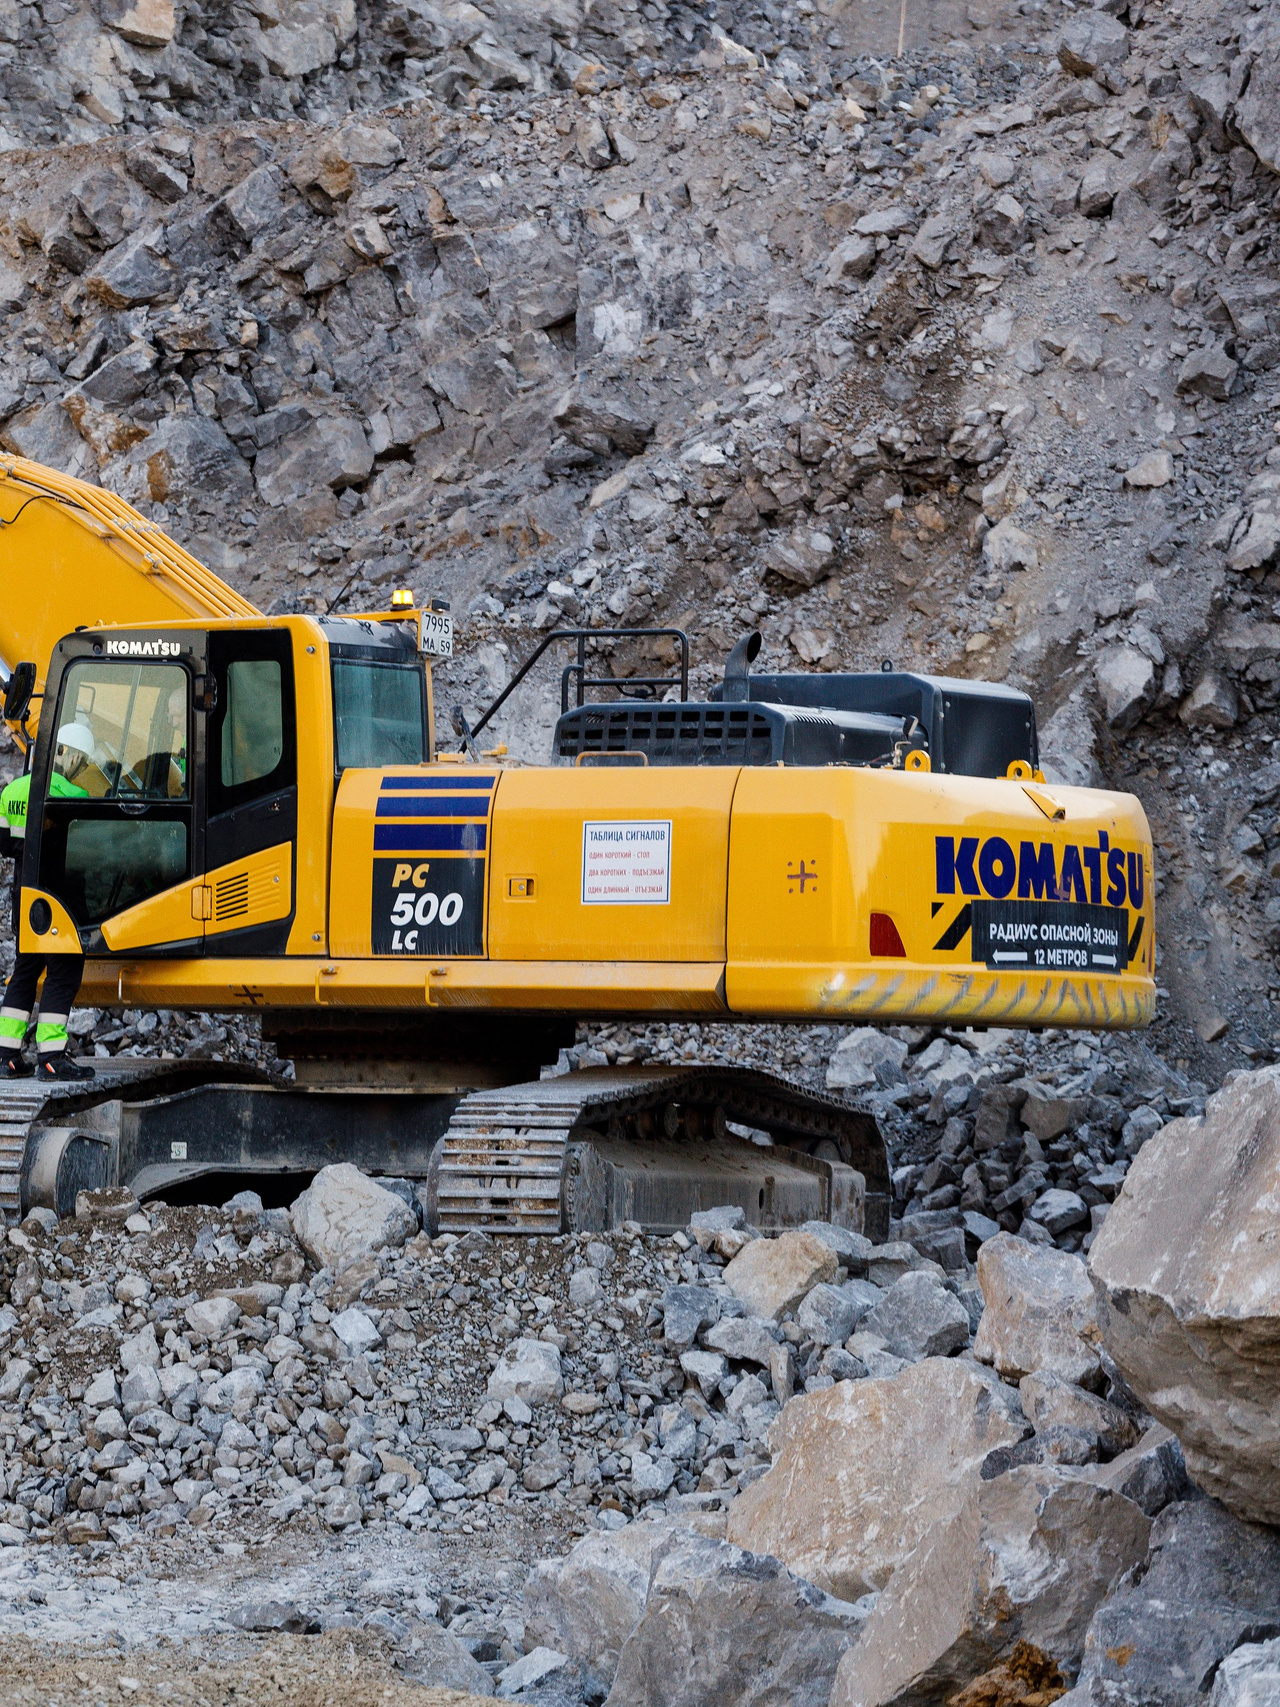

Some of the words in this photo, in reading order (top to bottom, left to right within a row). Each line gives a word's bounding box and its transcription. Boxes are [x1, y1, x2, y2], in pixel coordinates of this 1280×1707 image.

[425, 614, 450, 634] 7995
[107, 638, 180, 656] KOMATSU
[440, 640, 451, 653] 59
[590, 831, 623, 842] ТАБЛИЦА
[625, 830, 665, 841] СИГНАЛОВ
[605, 850, 631, 859] КОРОТКИЙ
[392, 863, 430, 888] PC
[588, 869, 599, 877] ДВА
[632, 867, 664, 876] ПОДЪЕЗЖАЙ
[935, 830, 1144, 910] KOMATSU
[603, 885, 630, 894] ДЛИННЫЙ
[635, 886, 662, 894] ОТЪЕЗЖАЙ
[390, 892, 464, 926] 500
[391, 930, 419, 950] LC
[989, 923, 1038, 943] РАДИУС
[1040, 923, 1092, 944] ОПАСНОЙ
[1093, 928, 1118, 946] ЗОНЫ
[1034, 949, 1045, 965] 12
[1047, 948, 1088, 966] МЕТРОВ
